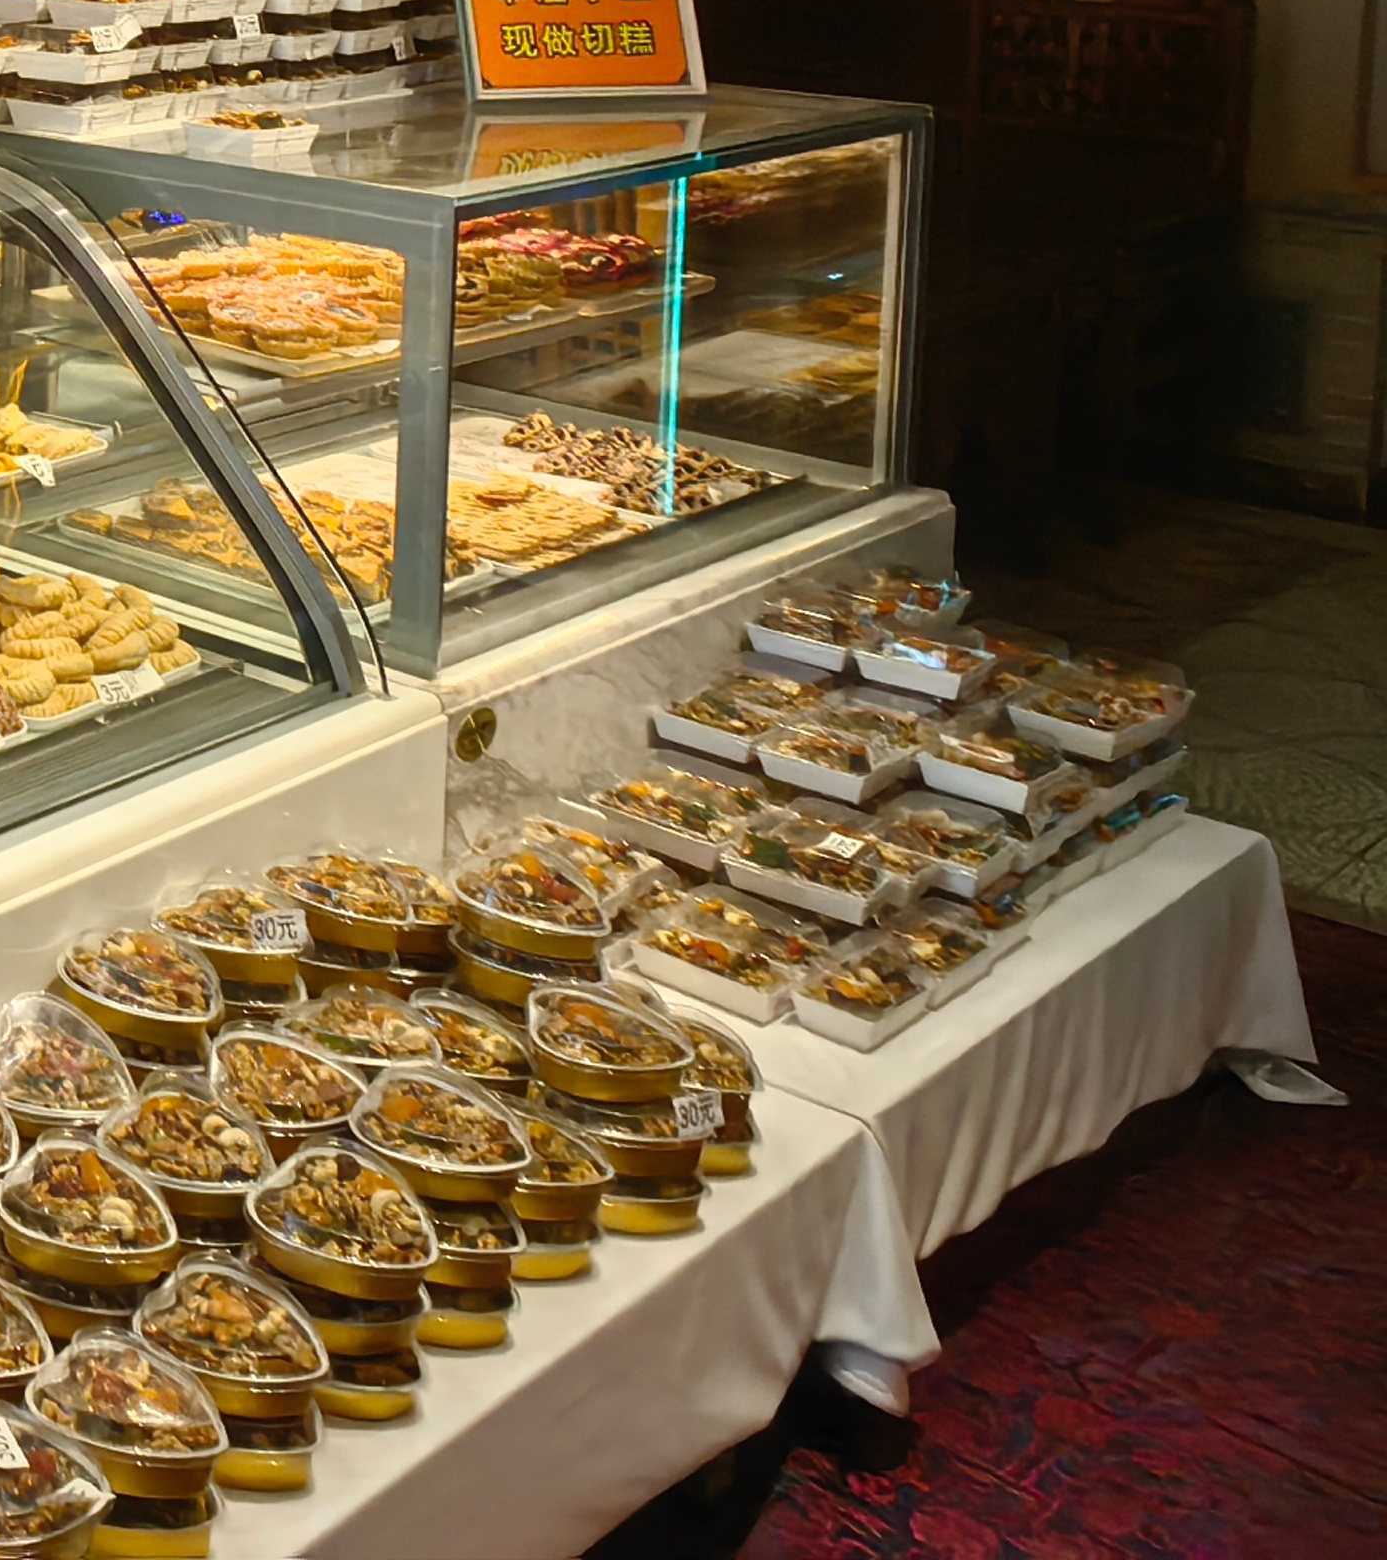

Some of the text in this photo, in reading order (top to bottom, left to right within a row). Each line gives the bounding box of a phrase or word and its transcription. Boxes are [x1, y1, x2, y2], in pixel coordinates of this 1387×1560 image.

[500, 21, 657, 57] 现做切糕
[103, 680, 131, 702] 3元
[252, 914, 299, 942] 30元
[679, 1091, 716, 1129] 30元
